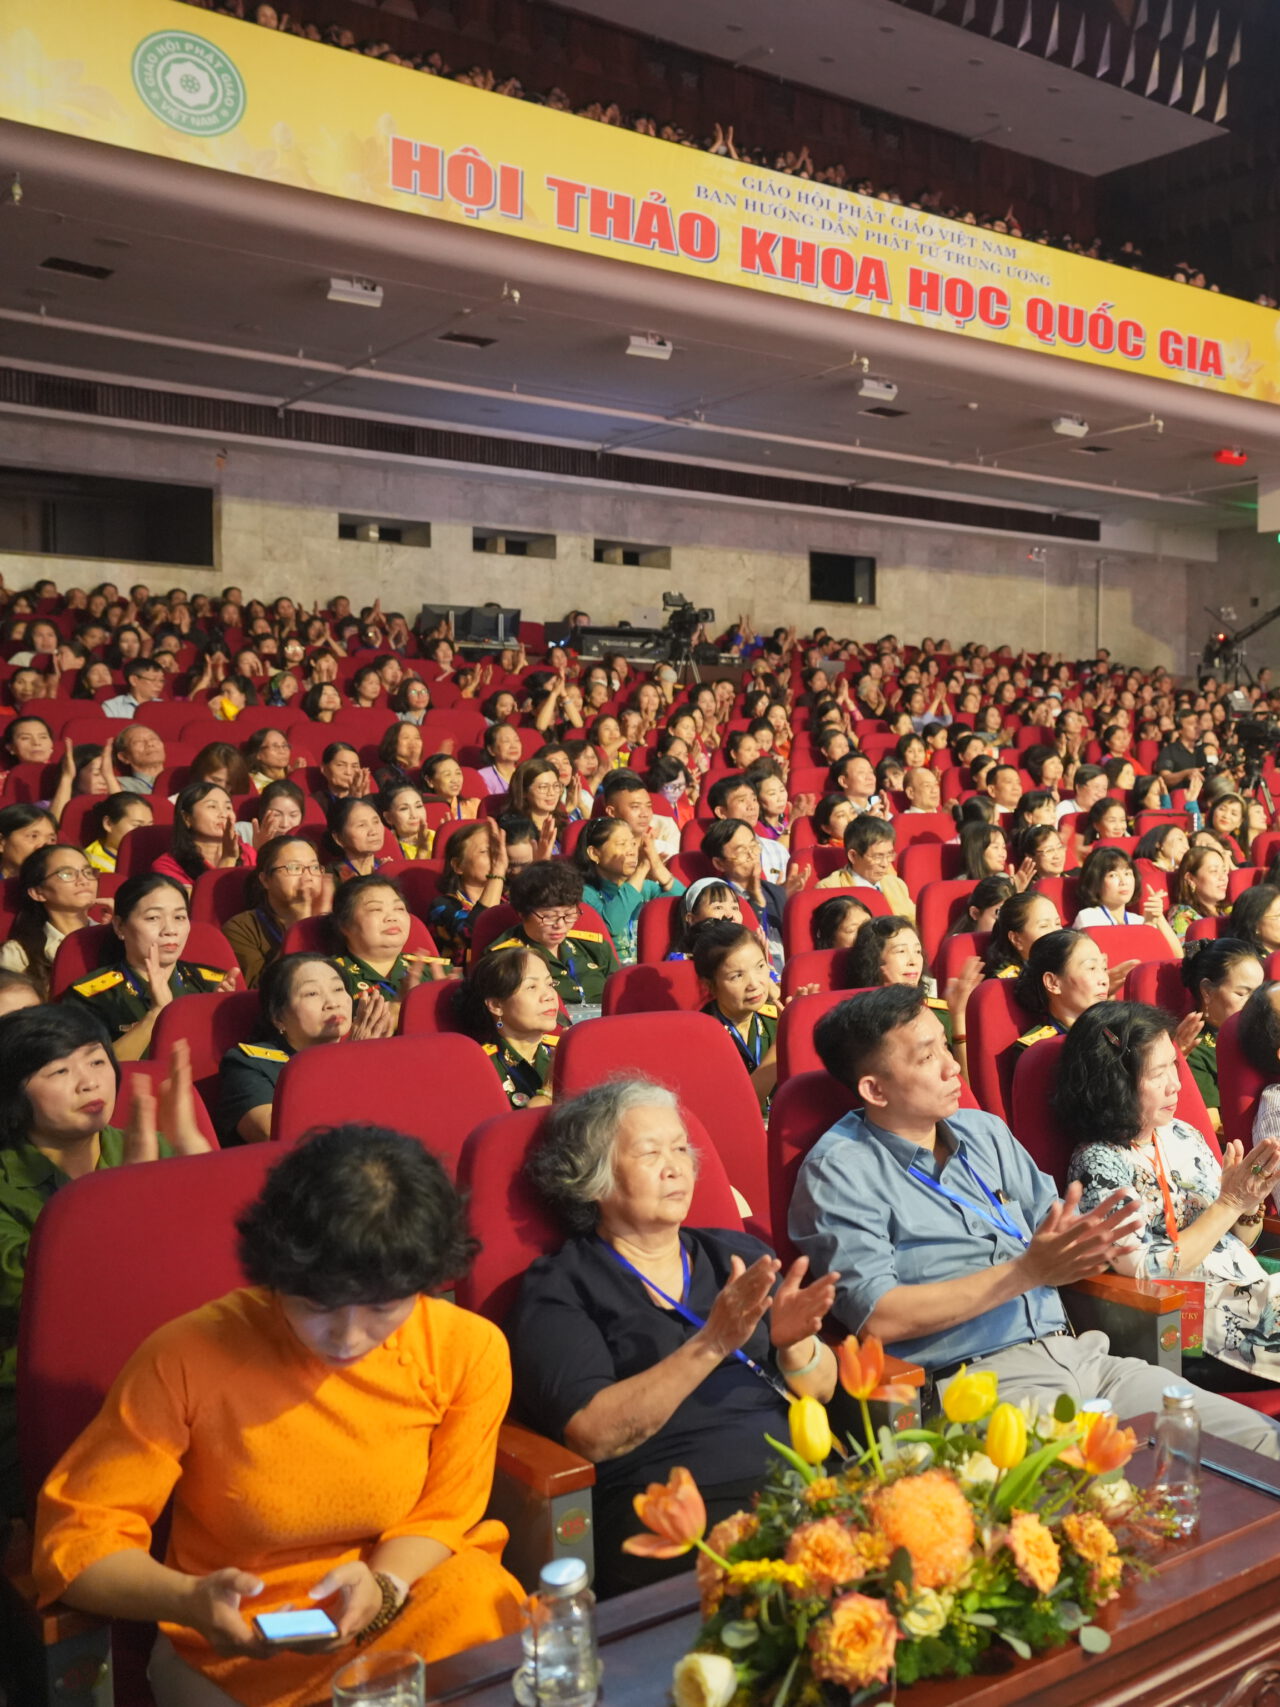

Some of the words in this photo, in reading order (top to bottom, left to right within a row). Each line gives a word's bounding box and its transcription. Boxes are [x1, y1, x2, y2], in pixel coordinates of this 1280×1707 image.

[390, 135, 523, 219] HỘI
[545, 175, 720, 263] THẢO
[740, 225, 892, 303] KHOA
[907, 266, 1011, 329] HỌC
[1026, 302, 1145, 360] QUỐC
[1159, 329, 1225, 378] GIA
[695, 184, 738, 206] BAN
[821, 215, 859, 238] DẪN
[865, 229, 912, 251] PHẬT
[944, 249, 1001, 274] TRUNG
[1006, 265, 1051, 286] ƯƠNG
[741, 175, 791, 199] GIÁO
[797, 191, 831, 211] HỘI
[838, 202, 886, 224] PHẬT
[890, 215, 934, 237] GIÁO
[938, 228, 977, 249] VIỆT
[982, 240, 1017, 259] NAM
